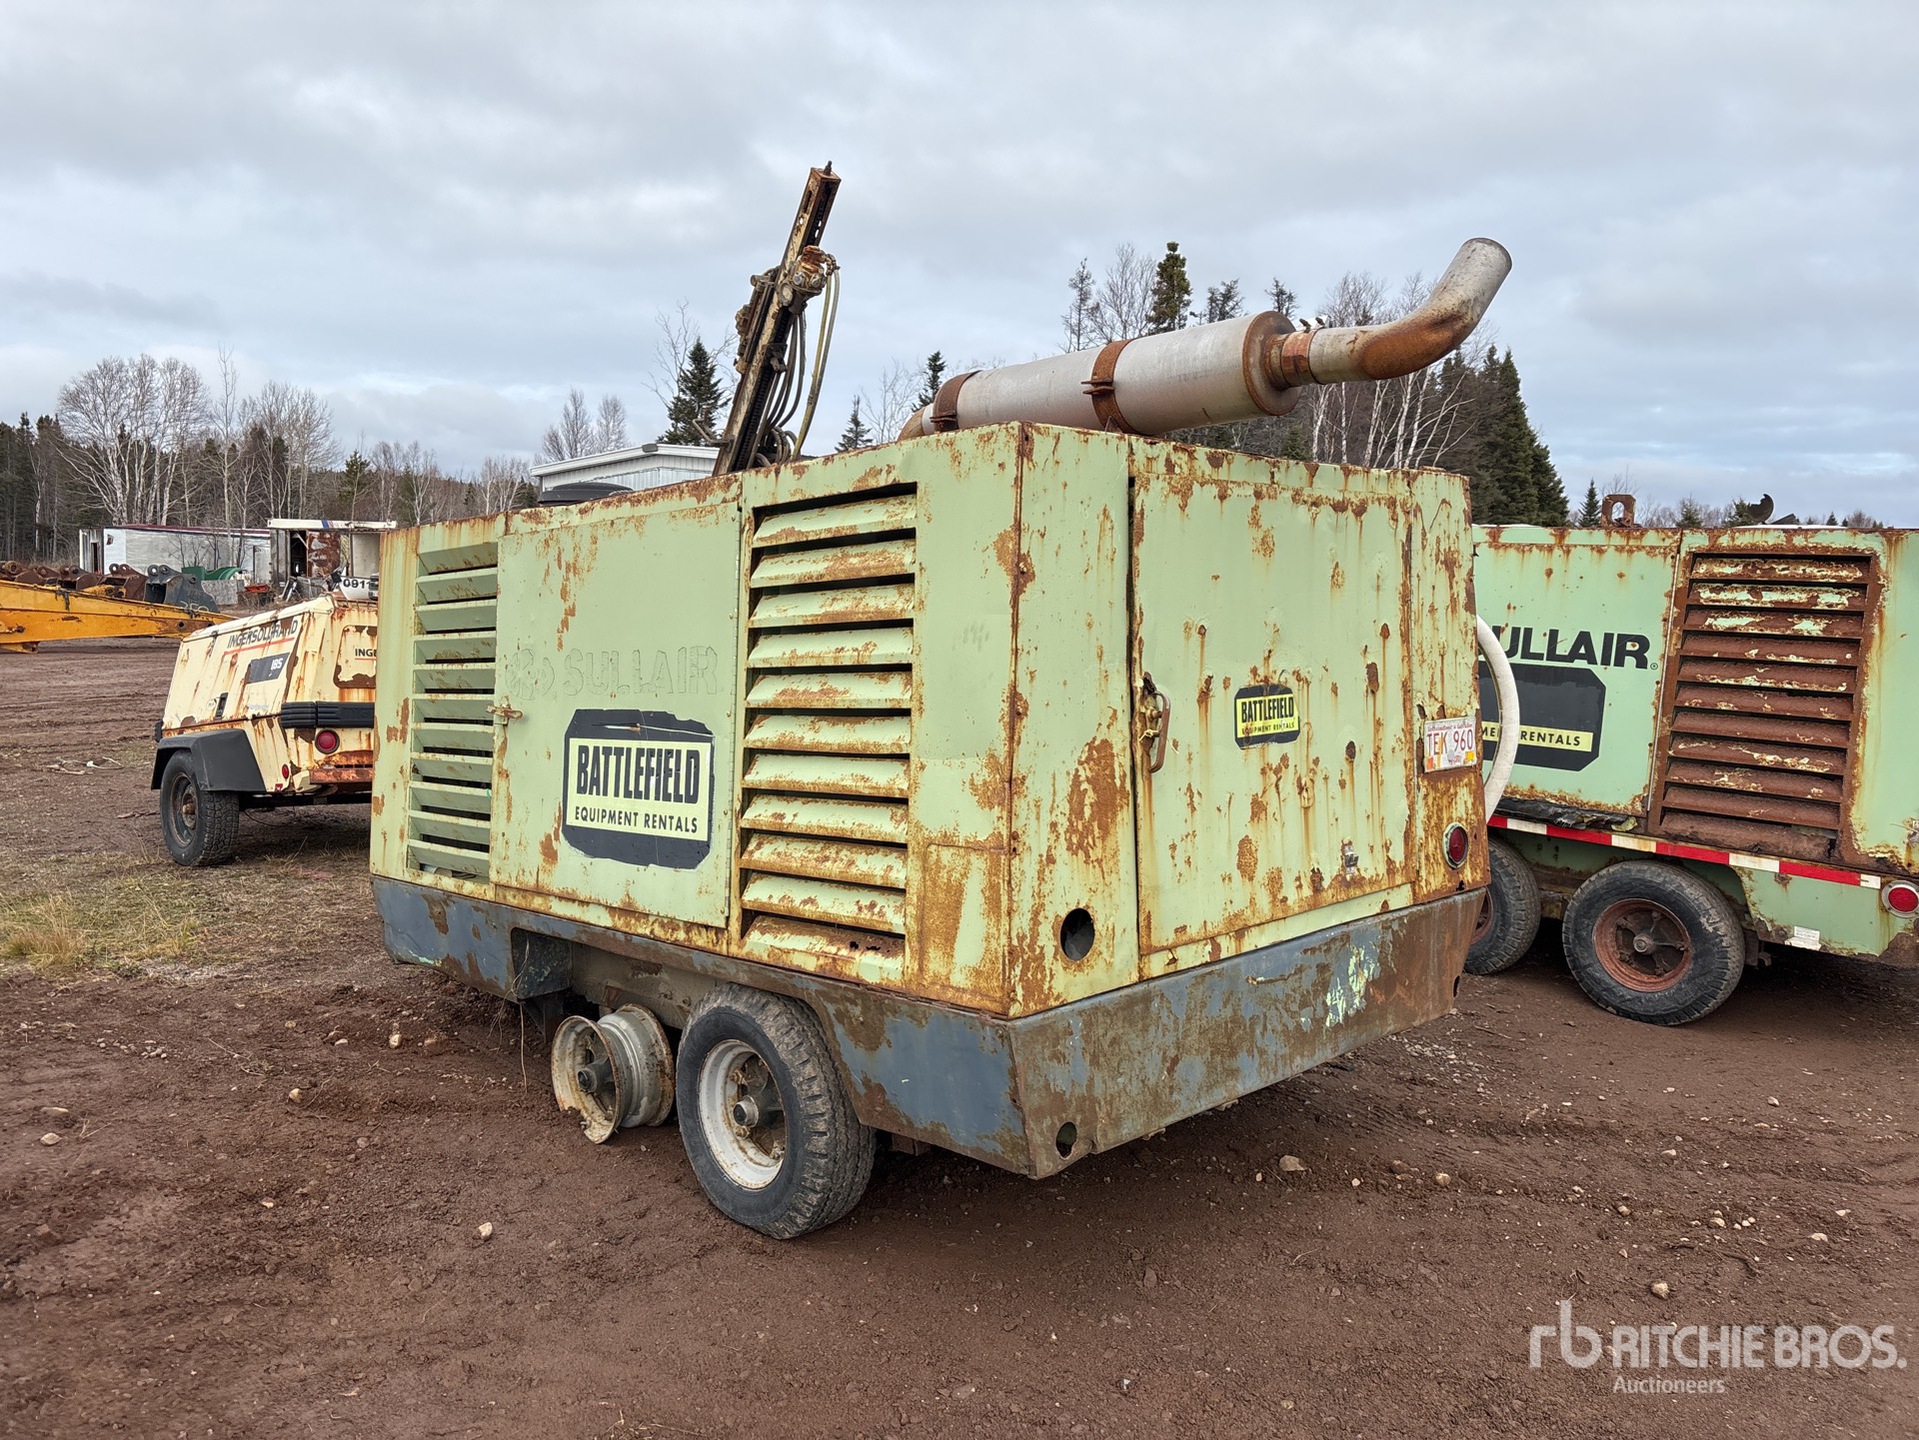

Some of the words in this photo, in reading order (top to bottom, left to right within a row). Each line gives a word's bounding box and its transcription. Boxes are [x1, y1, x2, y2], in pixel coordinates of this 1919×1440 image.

[1479, 625, 1650, 669] ULLAIR
[563, 646, 718, 696] SULLAIR
[1241, 696, 1294, 723] BATTLEFIELD
[1242, 725, 1272, 735] EUIPMENT
[1427, 731, 1448, 757] TEK
[1453, 729, 1474, 752] 960
[1520, 730, 1581, 746] RENTALS
[576, 745, 701, 805] BATTLEFIELD
[574, 806, 638, 827] EQUIPMENT
[643, 813, 698, 833] RENTALS
